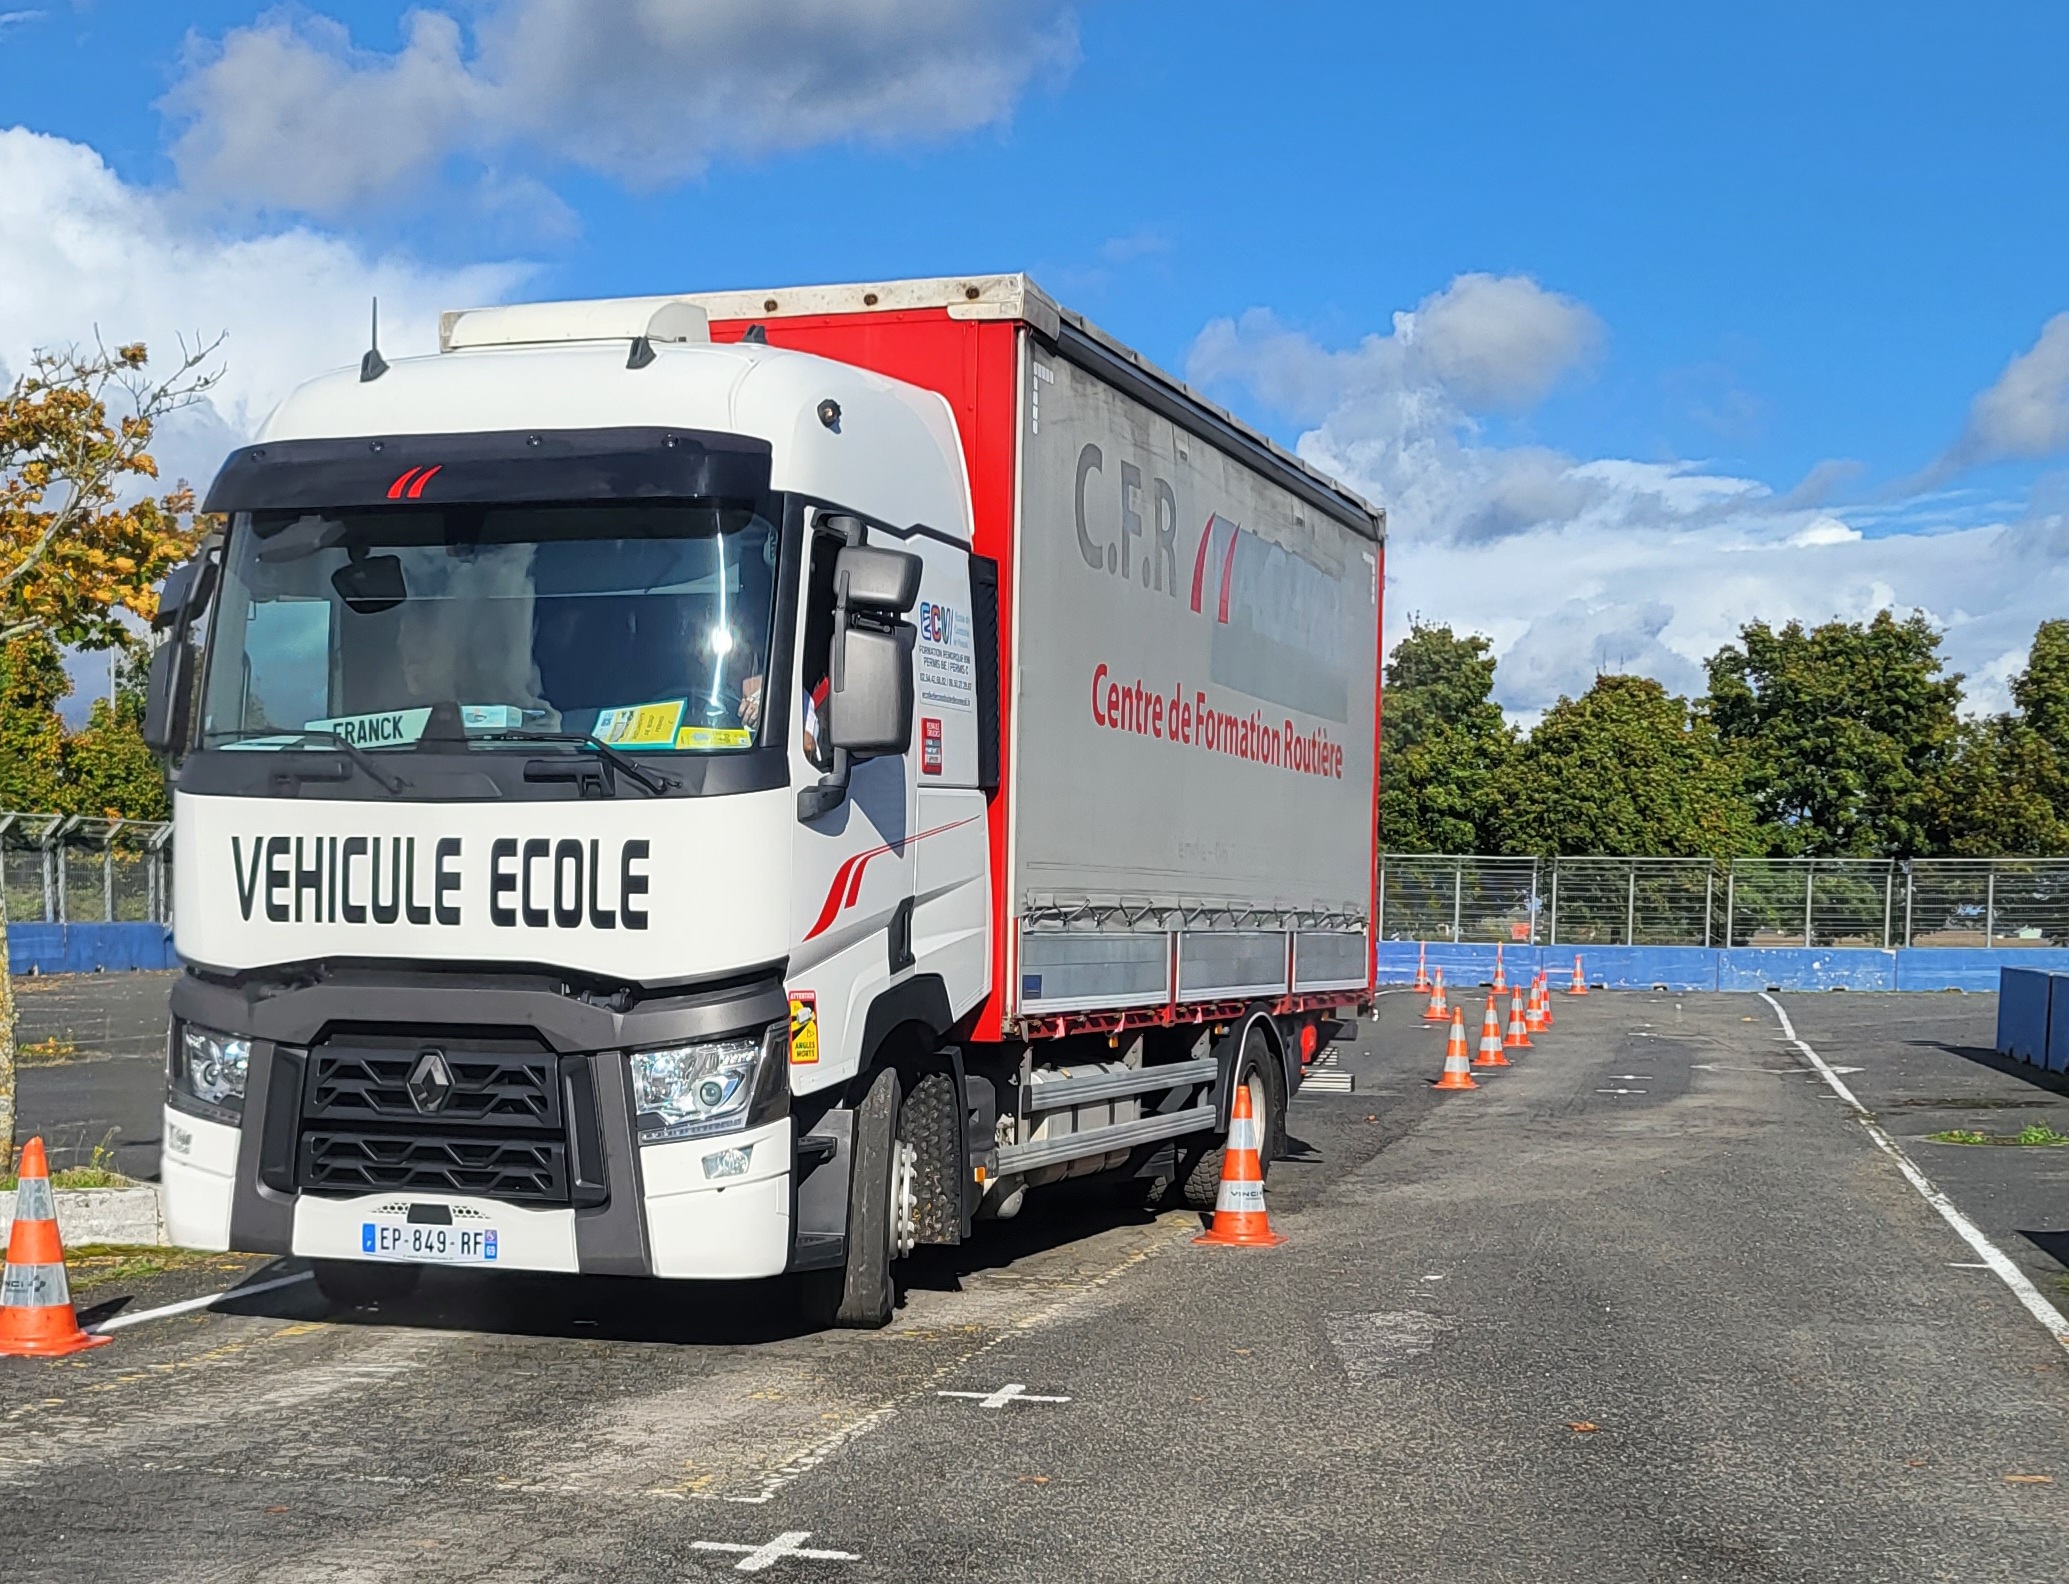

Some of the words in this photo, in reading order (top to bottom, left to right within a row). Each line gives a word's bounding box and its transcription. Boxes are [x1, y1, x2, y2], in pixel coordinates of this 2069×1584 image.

[1075, 443, 1177, 598] C.F.R
[334, 715, 404, 744] FRANCK
[1091, 663, 1162, 738] Centre
[1168, 682, 1191, 744] de
[1195, 691, 1281, 766] Formation
[1284, 719, 1343, 779] Routière
[231, 836, 461, 925] VEHICULE
[490, 838, 650, 930] ECOLE
